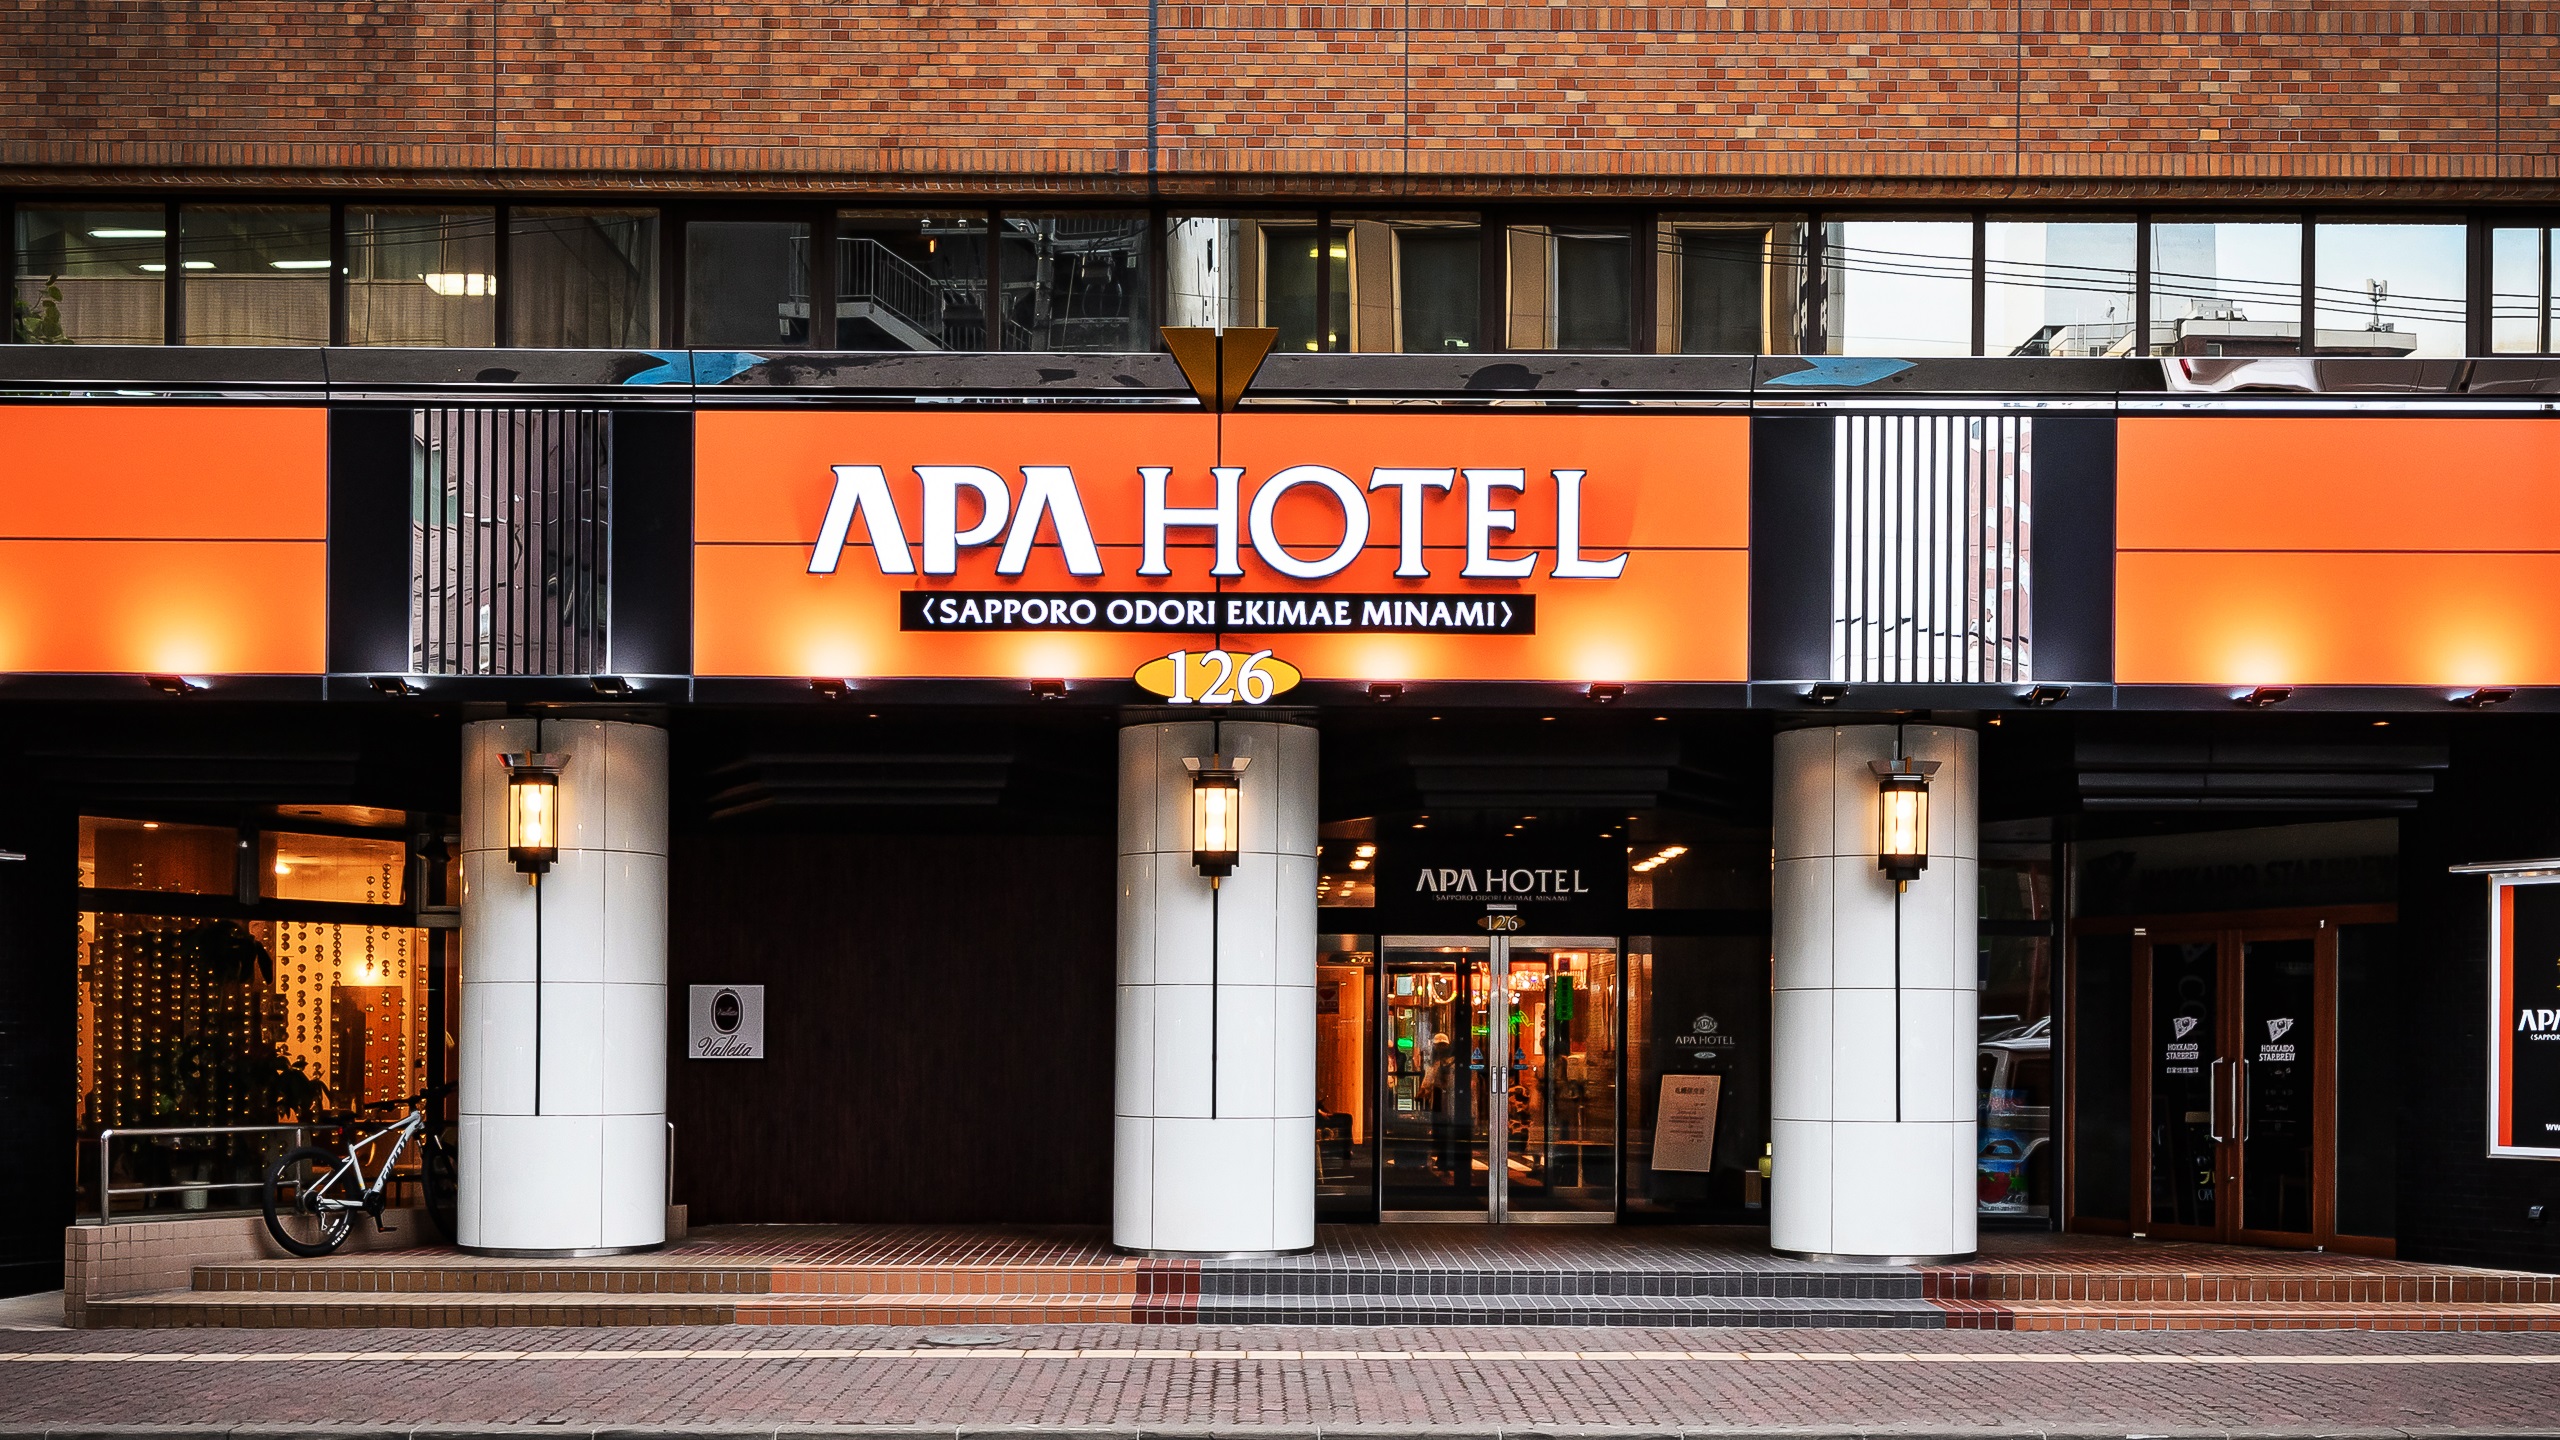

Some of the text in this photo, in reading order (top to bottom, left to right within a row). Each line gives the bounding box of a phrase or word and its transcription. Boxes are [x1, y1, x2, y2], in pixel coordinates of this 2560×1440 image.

[806, 464, 1630, 580] APA HOTEL
[1106, 599, 1216, 625] ODORI
[1226, 600, 1352, 626] EKIMAE
[1166, 649, 1274, 705] 126
[1416, 868, 1590, 893] APA HOTEL
[1475, 894, 1500, 902] ODORI
[1503, 894, 1533, 902] EKIMAE
[1486, 914, 1519, 932] 126
[697, 1035, 753, 1057] Valletta
[1675, 1035, 1736, 1045] APA HOTEL
[2260, 1044, 2295, 1053] HOKKAIDO
[2259, 1052, 2296, 1062] STARBREW
